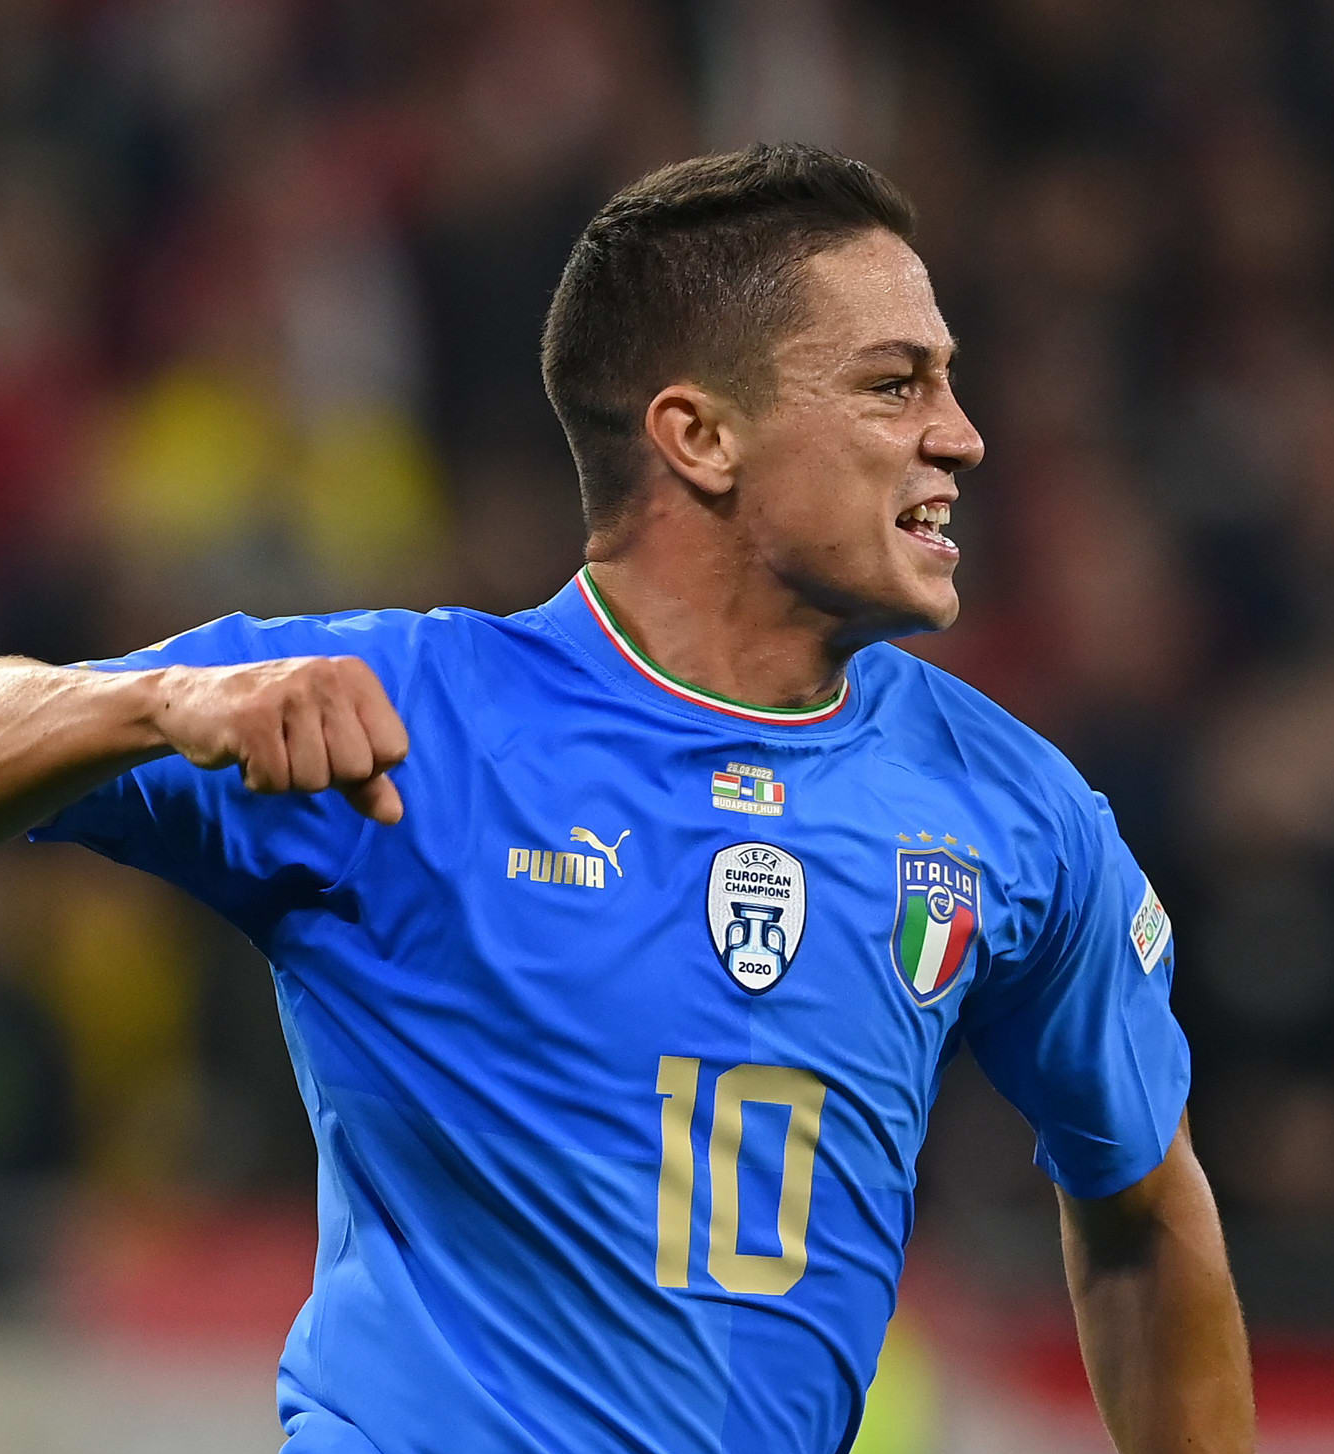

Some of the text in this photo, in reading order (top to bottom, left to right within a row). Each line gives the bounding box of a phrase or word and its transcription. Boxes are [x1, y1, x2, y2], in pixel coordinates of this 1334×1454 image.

[507, 847, 605, 889] PUMA
[740, 851, 777, 869] UEFA
[725, 869, 791, 887] EUROPEAN
[905, 861, 973, 896] ITALIA
[725, 882, 791, 899] CHAMPIONS
[738, 961, 772, 975] 2020
[655, 1055, 827, 1296] 10
